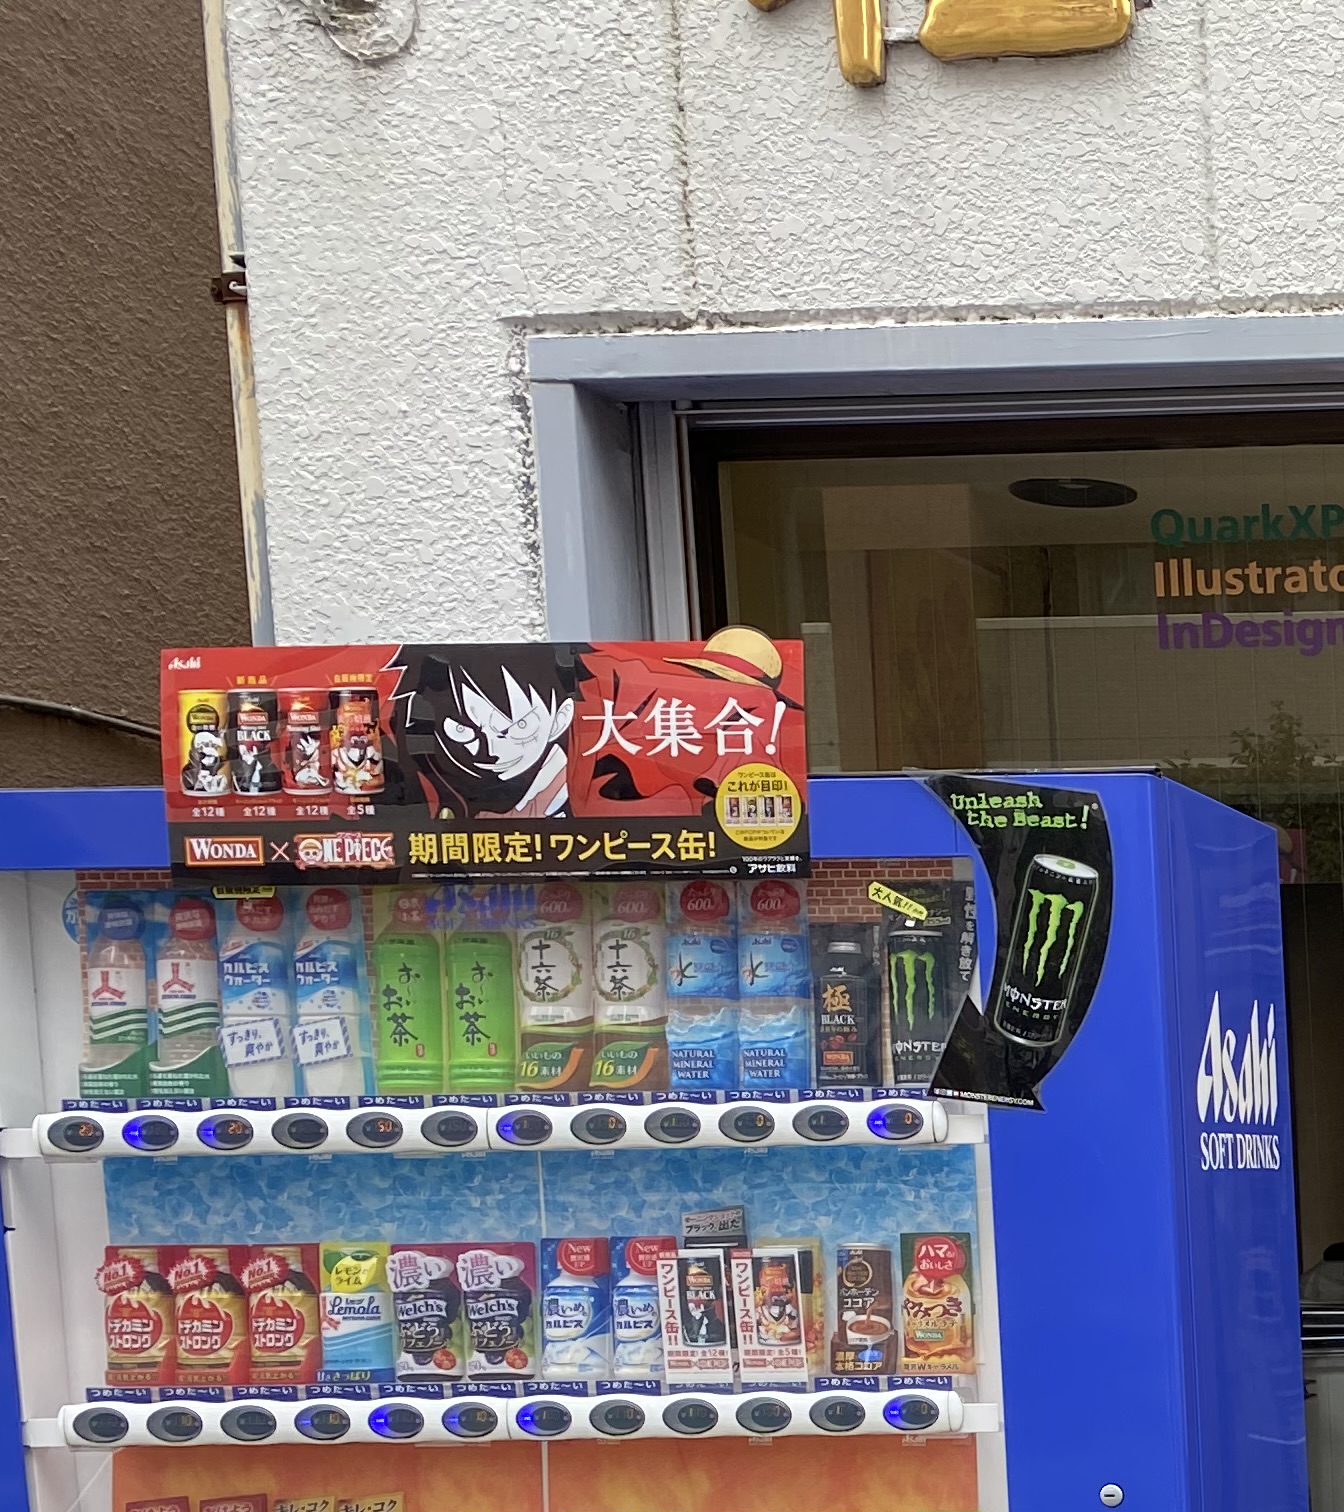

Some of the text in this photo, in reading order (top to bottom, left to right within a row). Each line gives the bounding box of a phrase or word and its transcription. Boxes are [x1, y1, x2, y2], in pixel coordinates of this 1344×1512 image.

[581, 697, 787, 757] 大集合!
[236, 730, 271, 742] BLACK
[950, 791, 1043, 812] Unleash
[967, 811, 1008, 828] the
[189, 838, 257, 860] WONDA
[408, 829, 716, 865] 期間限定! ワンピース缶!
[223, 961, 270, 974] カルピス
[295, 960, 339, 973] カルピス
[531, 939, 560, 1002] 十六茶
[607, 939, 635, 1001] 十六茶
[822, 983, 853, 1013] 極
[820, 1014, 855, 1025] BLACK
[672, 1049, 715, 1058] NATURAL
[743, 1048, 786, 1057] NATURAL
[1196, 990, 1279, 1127] Asahi
[673, 1060, 714, 1069] MINERAL
[744, 1059, 784, 1068] MINERAL
[677, 1070, 710, 1079] WATER
[749, 1069, 781, 1078] WATER
[1200, 1131, 1281, 1171] SOFT DRINKS
[567, 1242, 592, 1253] New
[635, 1241, 659, 1253] New
[461, 1252, 514, 1288] 濃い
[919, 1259, 954, 1270] おいしさ
[390, 1254, 442, 1289] 濃い
[686, 1289, 716, 1300] BLACK
[329, 1296, 381, 1316] Lemola
[468, 1299, 517, 1317] Welch's
[843, 1298, 875, 1308] ココア
[545, 1319, 584, 1329] カルピス
[616, 1319, 654, 1330] カルピス
[109, 1334, 152, 1349] ストロング
[179, 1335, 222, 1349] ストロング
[253, 1333, 295, 1347] ストロング
[835, 1361, 883, 1371] 本格ココア
